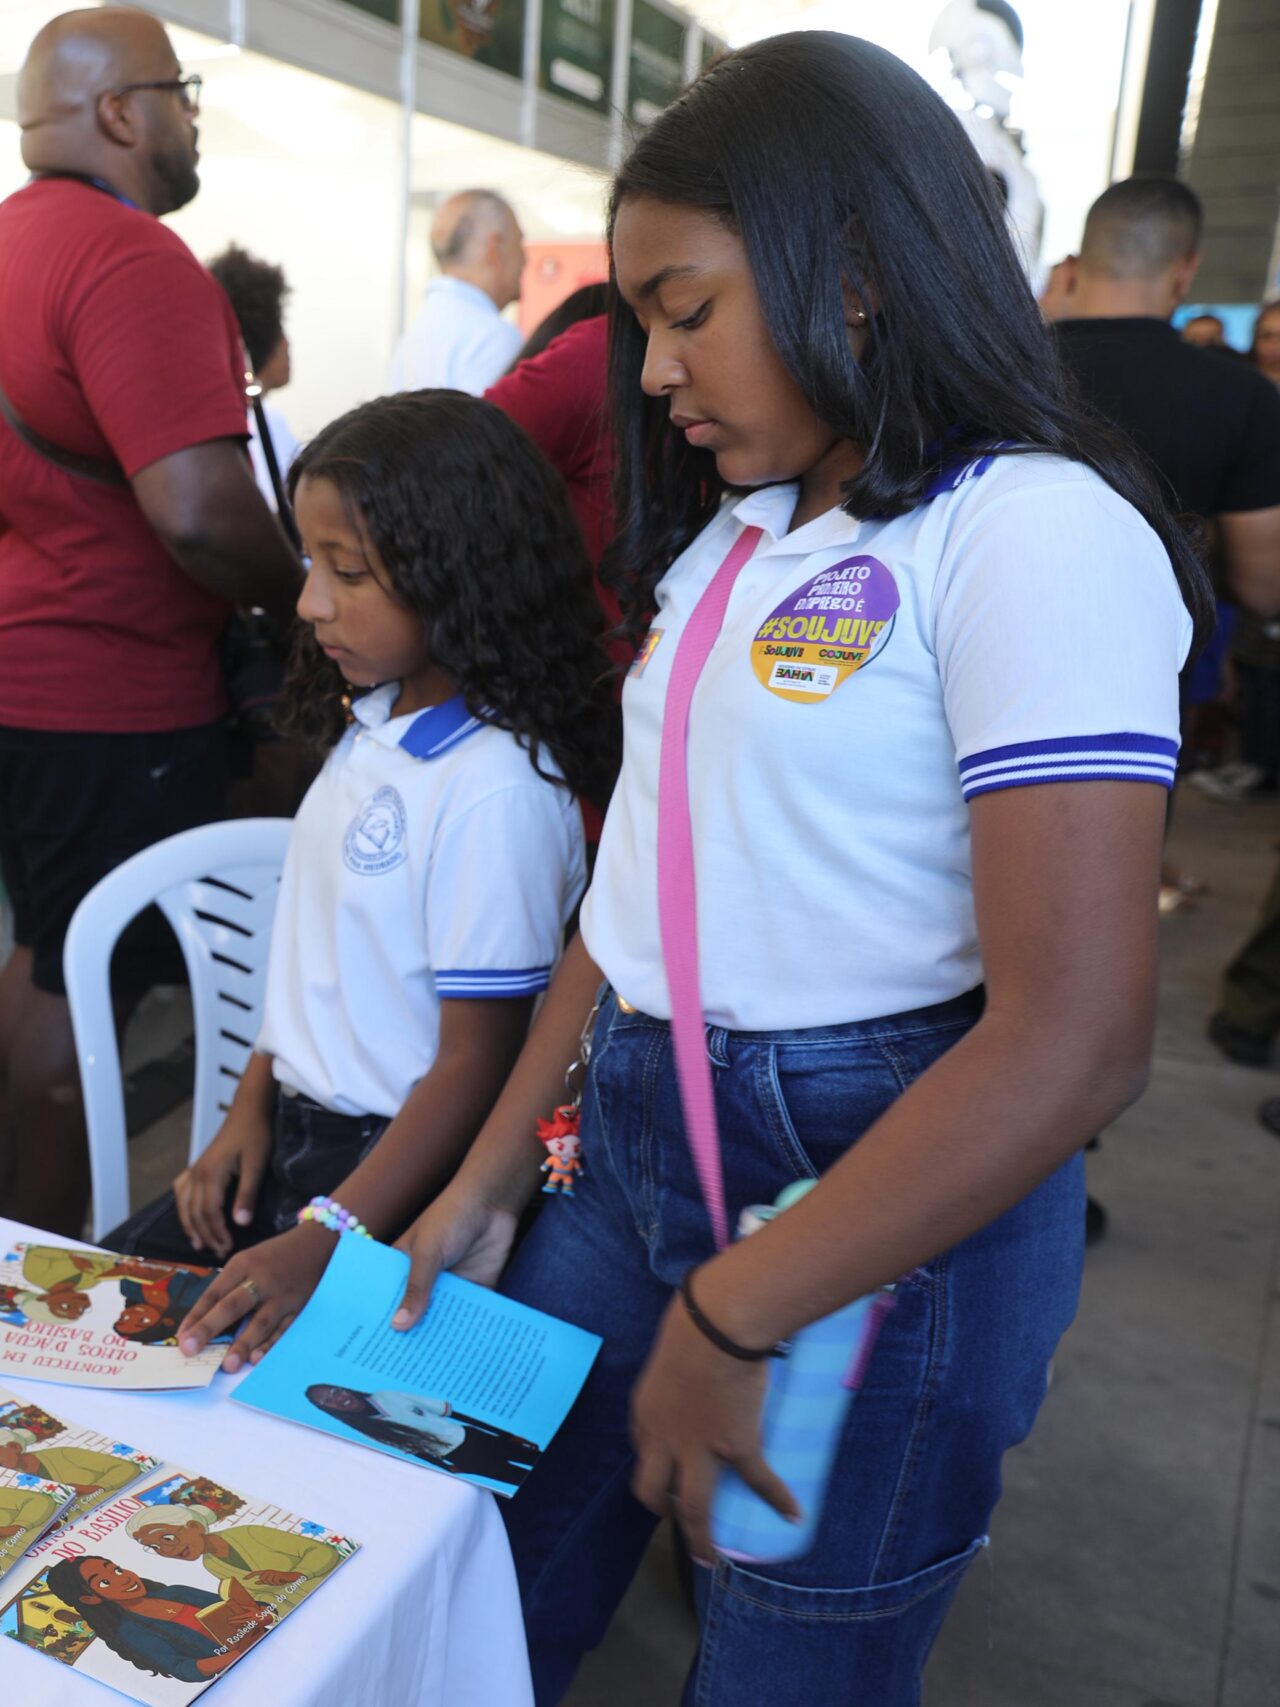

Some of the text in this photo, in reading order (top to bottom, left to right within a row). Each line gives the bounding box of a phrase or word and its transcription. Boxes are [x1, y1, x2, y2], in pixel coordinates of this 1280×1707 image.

[102, 1334, 129, 1349] DO
[2, 1350, 124, 1376] ACONTECEU EM
[78, 1344, 138, 1362] OLHOS
[5, 1527, 26, 1547] Carmo
[51, 1541, 87, 1562] DO
[213, 1644, 229, 1656] Por
[226, 1619, 259, 1645] Rosileide
[255, 1602, 278, 1620] Souza
[284, 1575, 308, 1594] Carmo
